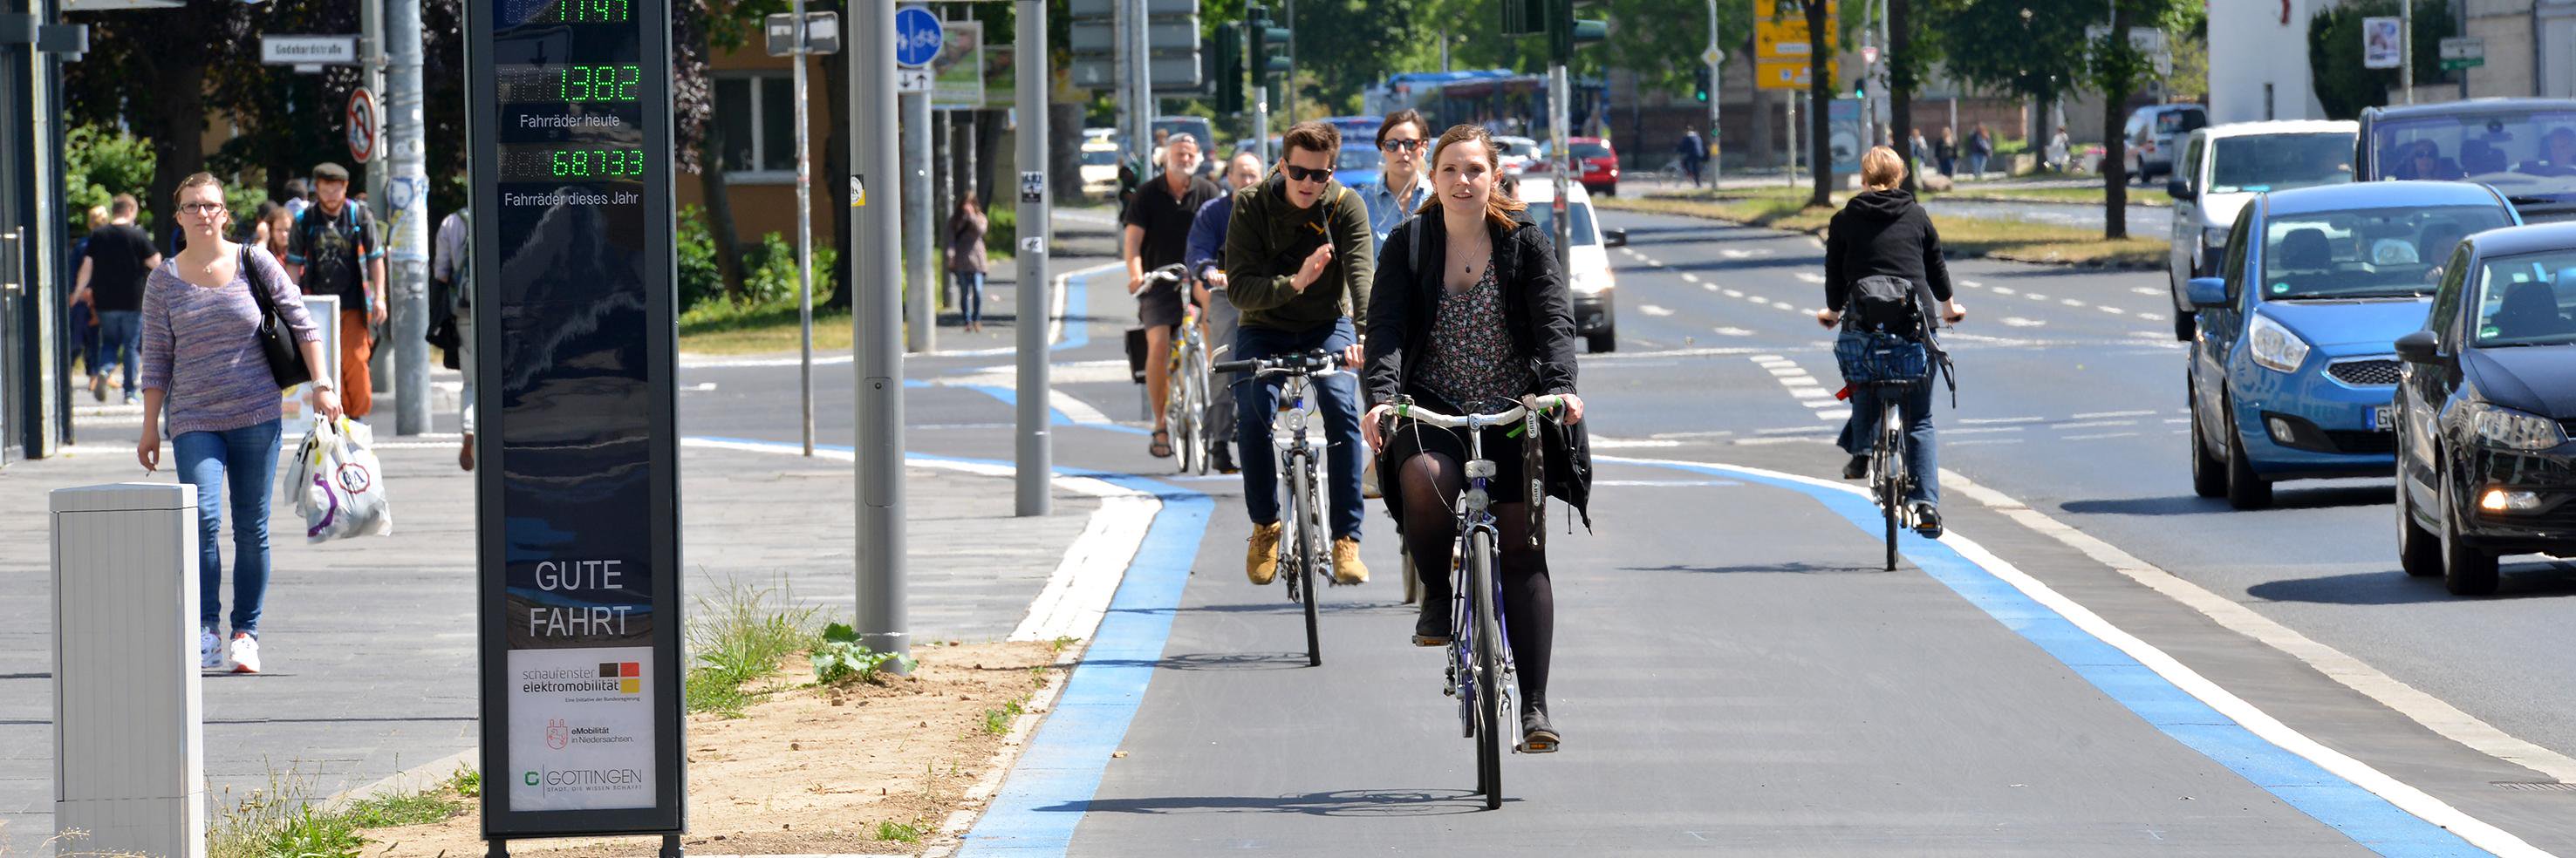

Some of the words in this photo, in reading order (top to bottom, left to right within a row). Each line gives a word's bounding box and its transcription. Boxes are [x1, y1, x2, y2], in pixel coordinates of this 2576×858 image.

[520, 114, 582, 128] Fahrräder
[584, 113, 620, 127] heute
[552, 150, 644, 176] 68.733
[504, 193, 565, 207] Fahrräder
[568, 192, 608, 205] dieses
[612, 191, 639, 205] Jahr
[536, 560, 623, 591] GUTE
[530, 605, 632, 637] FAHRT
[523, 667, 595, 680] schaufenster
[523, 679, 618, 692] elektromobilität
